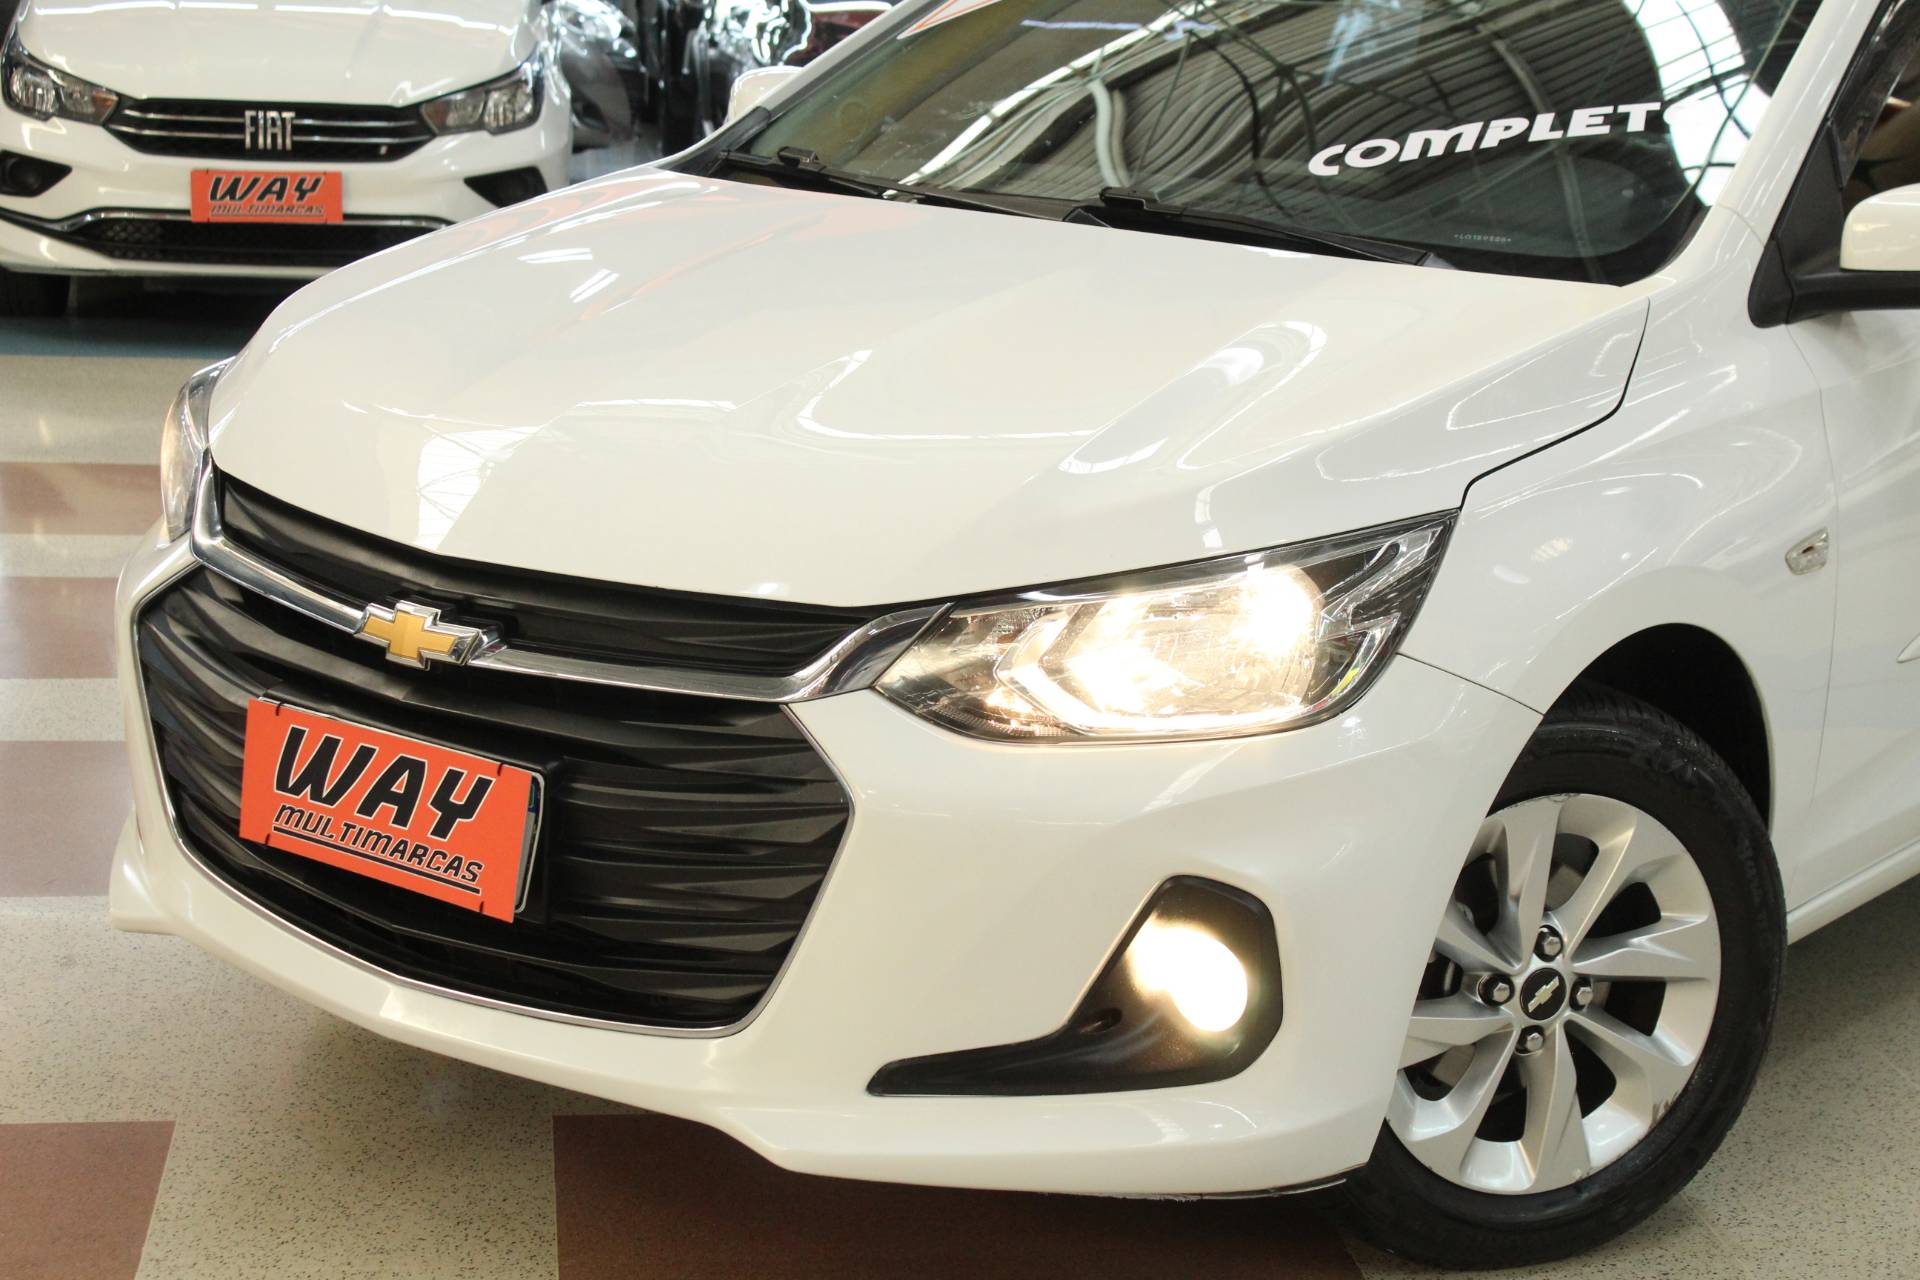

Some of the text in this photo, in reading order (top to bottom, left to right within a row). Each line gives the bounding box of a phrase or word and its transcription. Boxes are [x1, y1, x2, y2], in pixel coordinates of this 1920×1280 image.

[244, 110, 296, 151] FIAT
[209, 175, 324, 203] WAY
[273, 724, 496, 842] WAY
[272, 803, 484, 884] MULTIMARCAS
